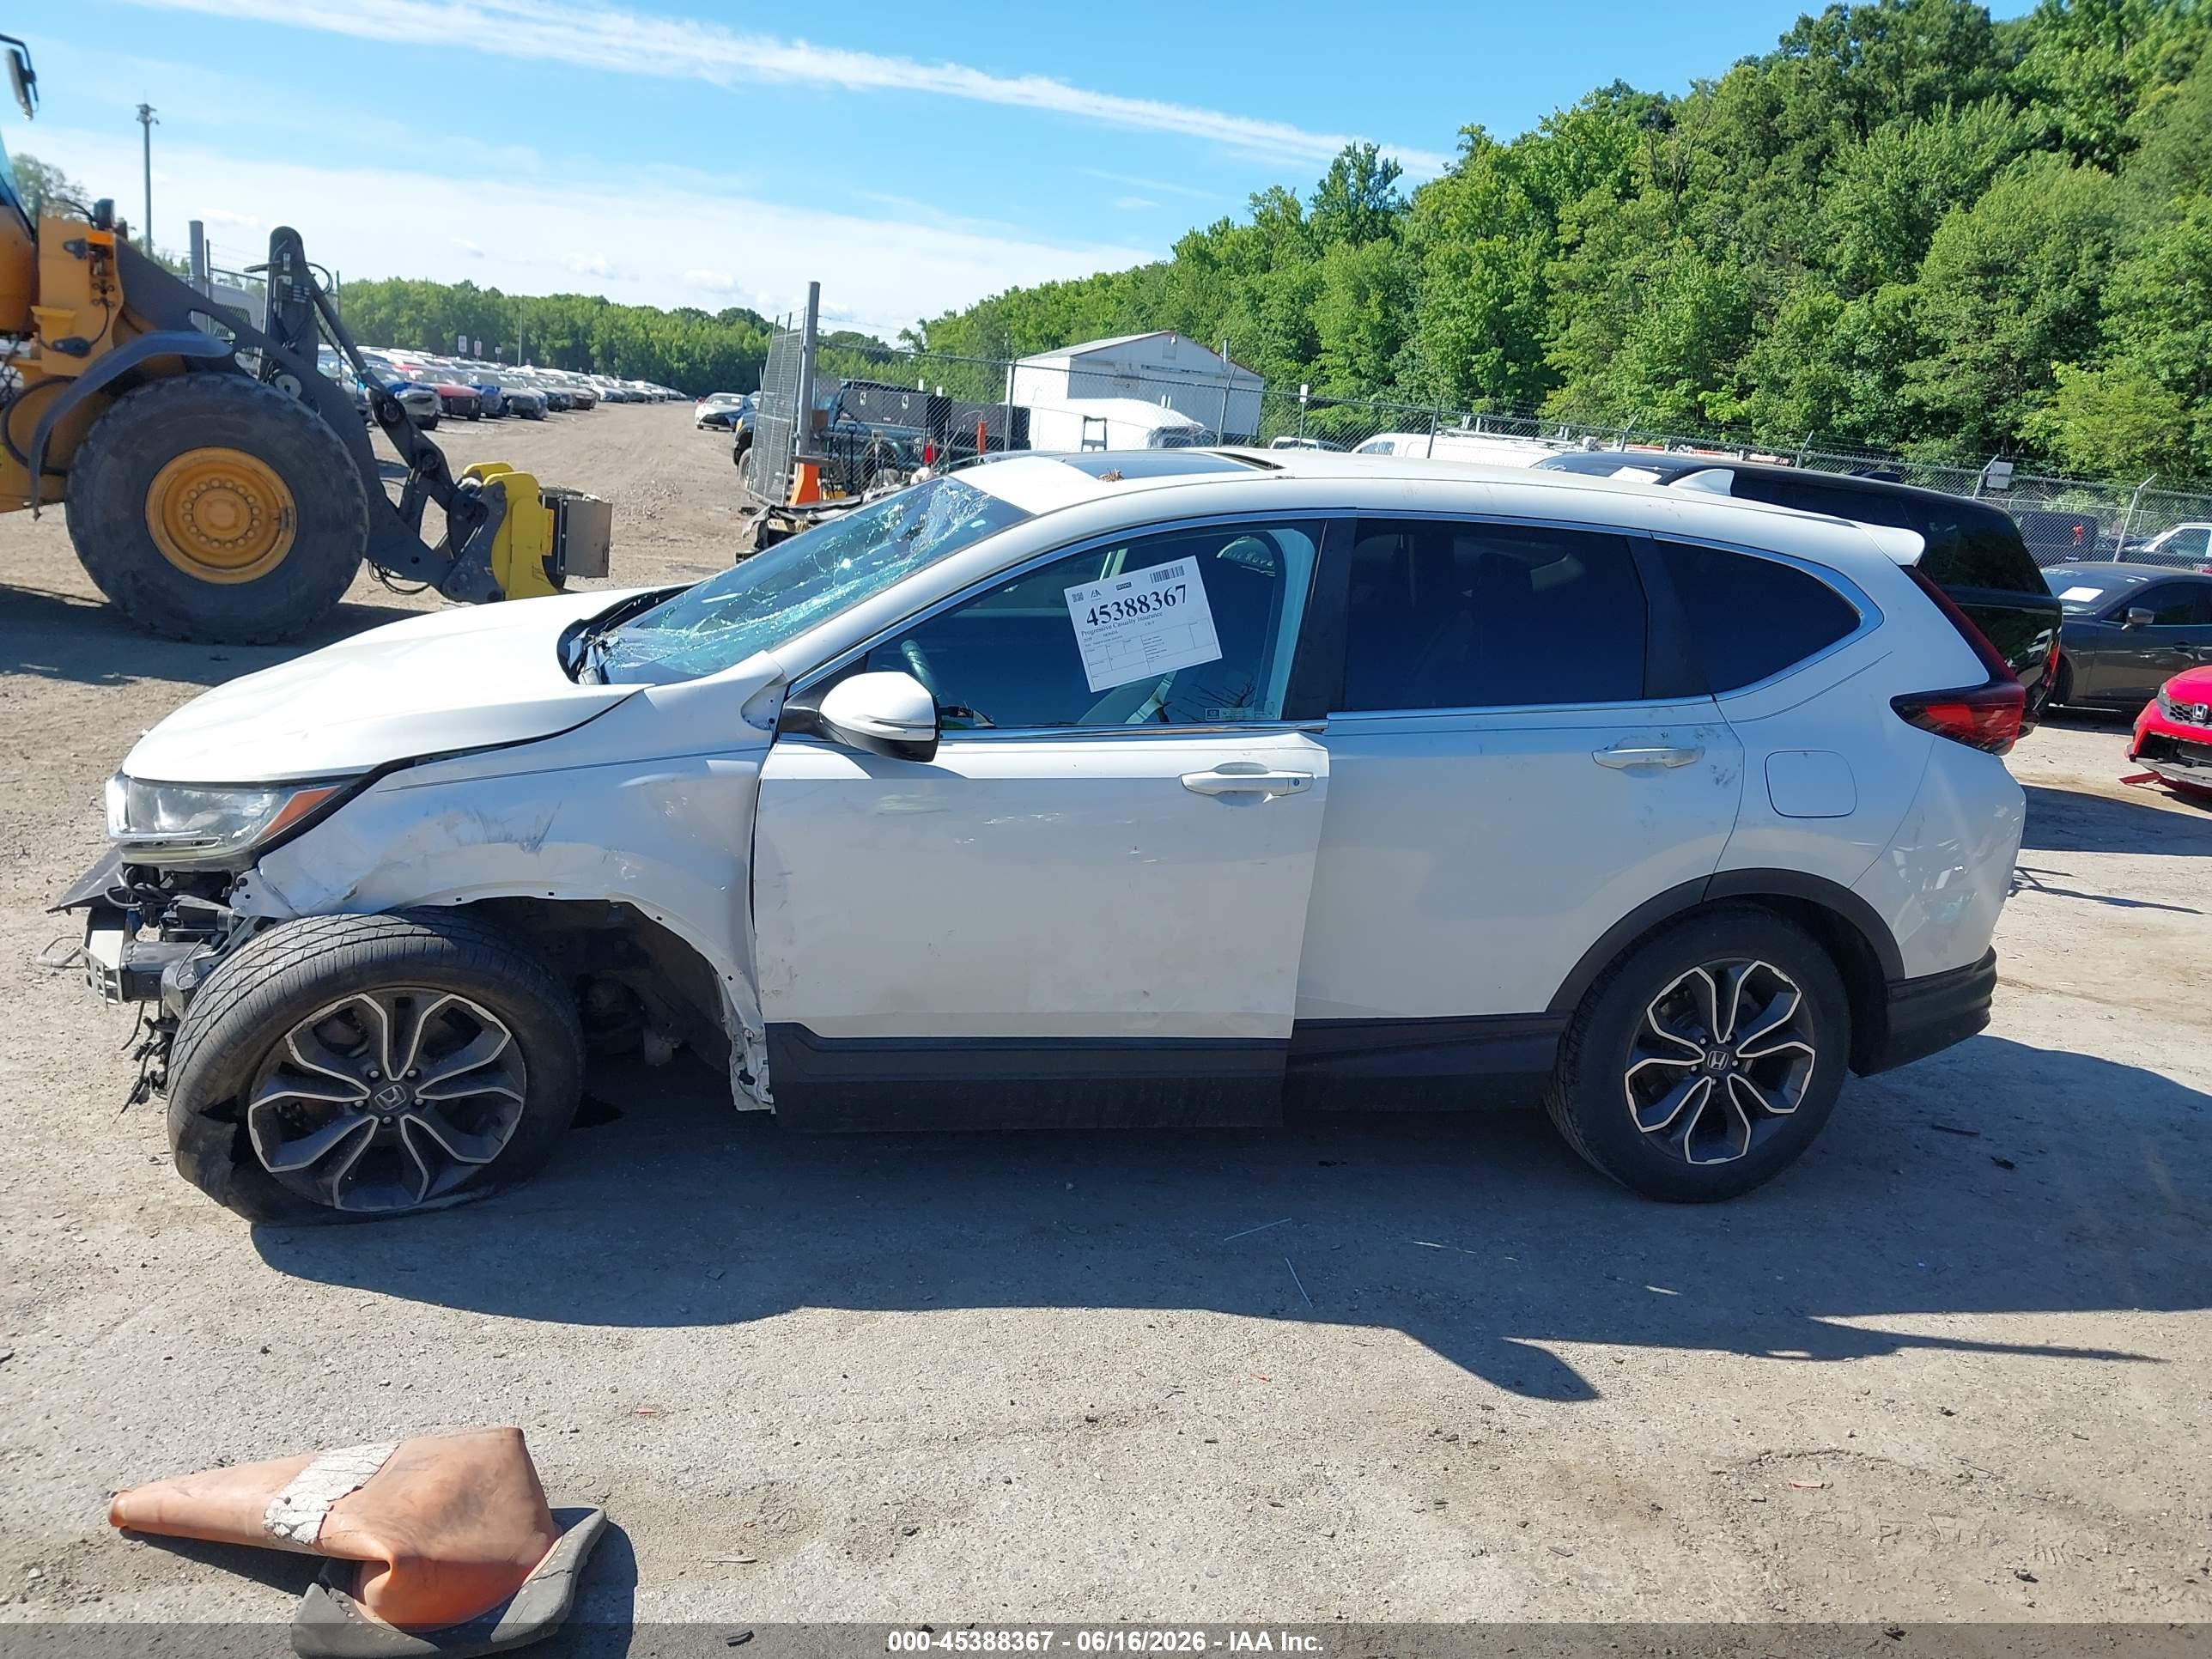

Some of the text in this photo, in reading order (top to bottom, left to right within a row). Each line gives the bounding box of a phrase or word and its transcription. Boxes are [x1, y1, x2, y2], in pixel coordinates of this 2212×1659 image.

[1086, 584, 1186, 626] 45388367
[1081, 612, 1163, 636] Progressive Casualty Insurance
